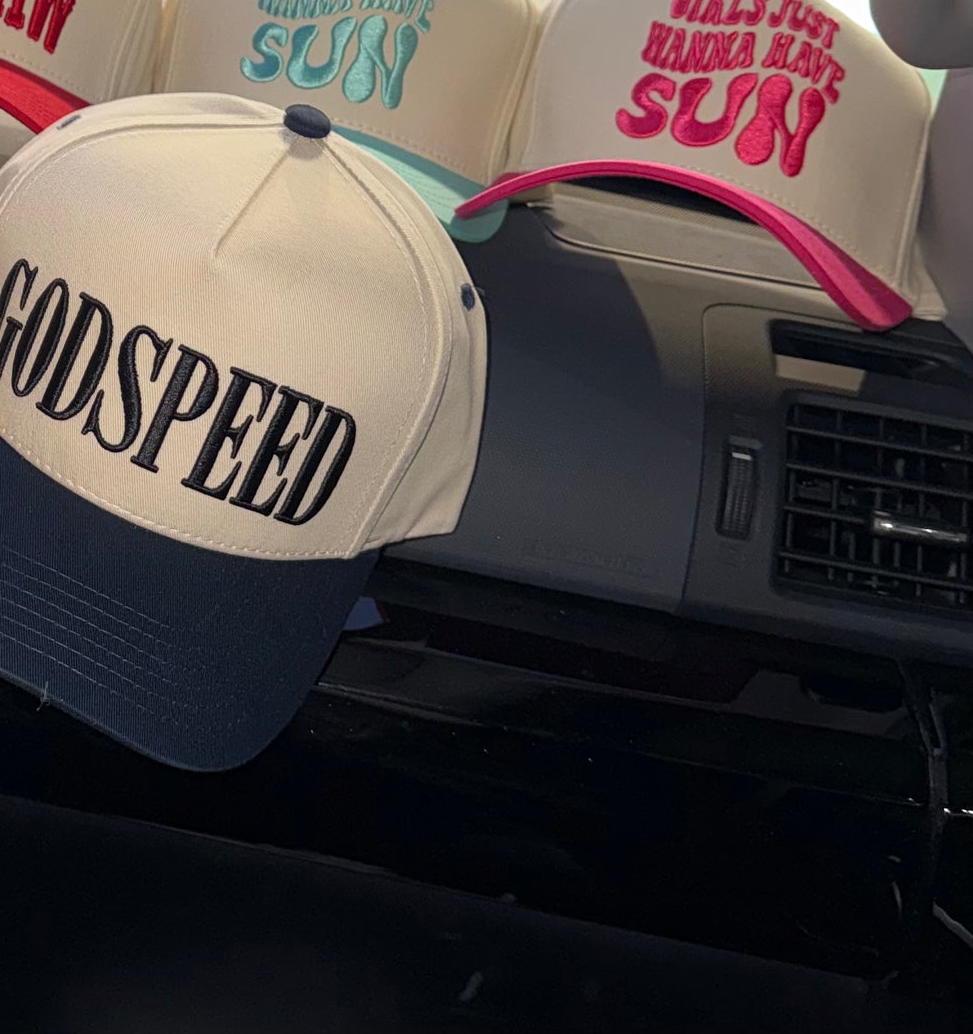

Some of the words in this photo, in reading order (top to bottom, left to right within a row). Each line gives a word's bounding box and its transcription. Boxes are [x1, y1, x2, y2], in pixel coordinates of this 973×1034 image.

[240, 14, 419, 109] SUN
[641, 21, 756, 74] WANNA
[761, 32, 845, 104] HAVE
[615, 72, 826, 178] SUN
